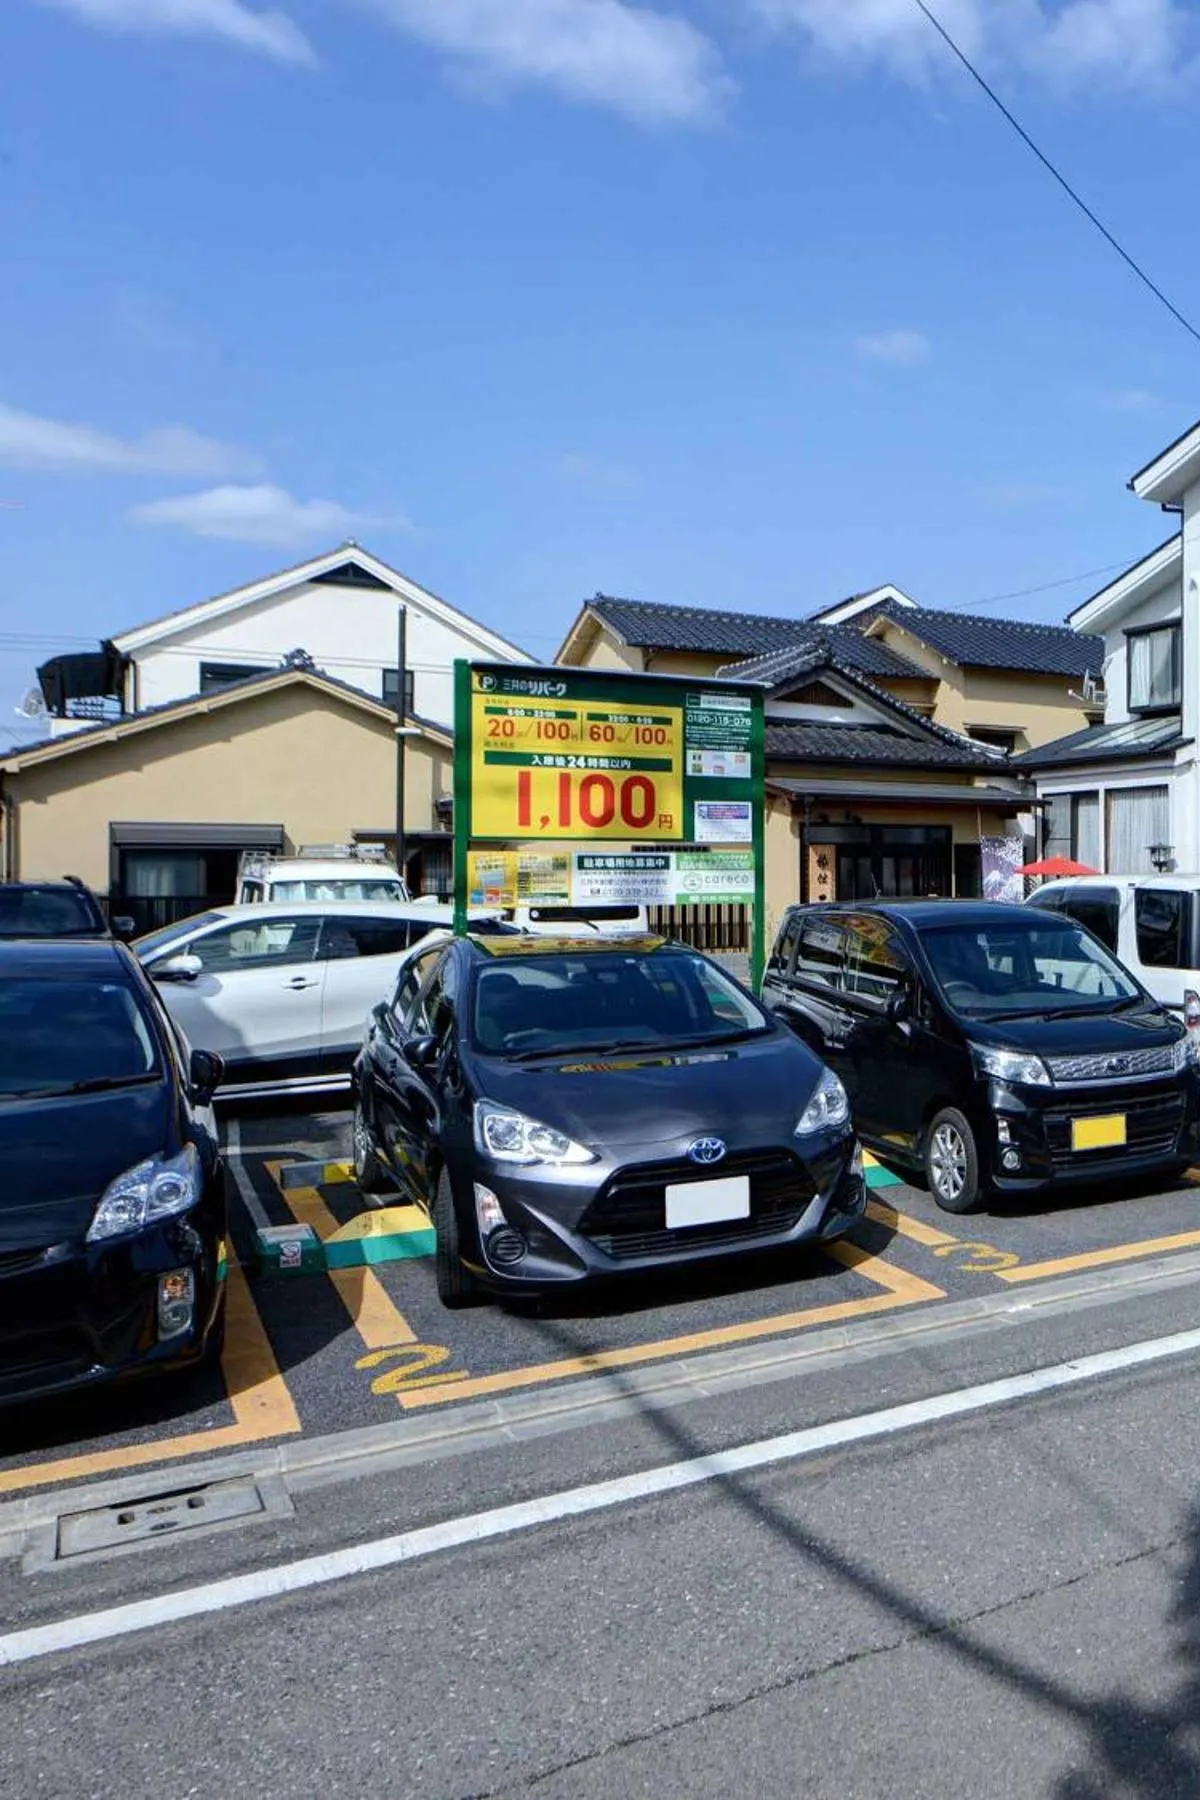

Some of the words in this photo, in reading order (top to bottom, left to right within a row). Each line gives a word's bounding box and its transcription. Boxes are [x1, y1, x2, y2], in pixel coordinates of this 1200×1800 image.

[503, 678, 567, 697] 三井のリパーク
[518, 771, 673, 830] 1,100円
[704, 874, 749, 885] careco
[932, 1242, 1020, 1273] 3
[355, 1344, 470, 1394] 2
